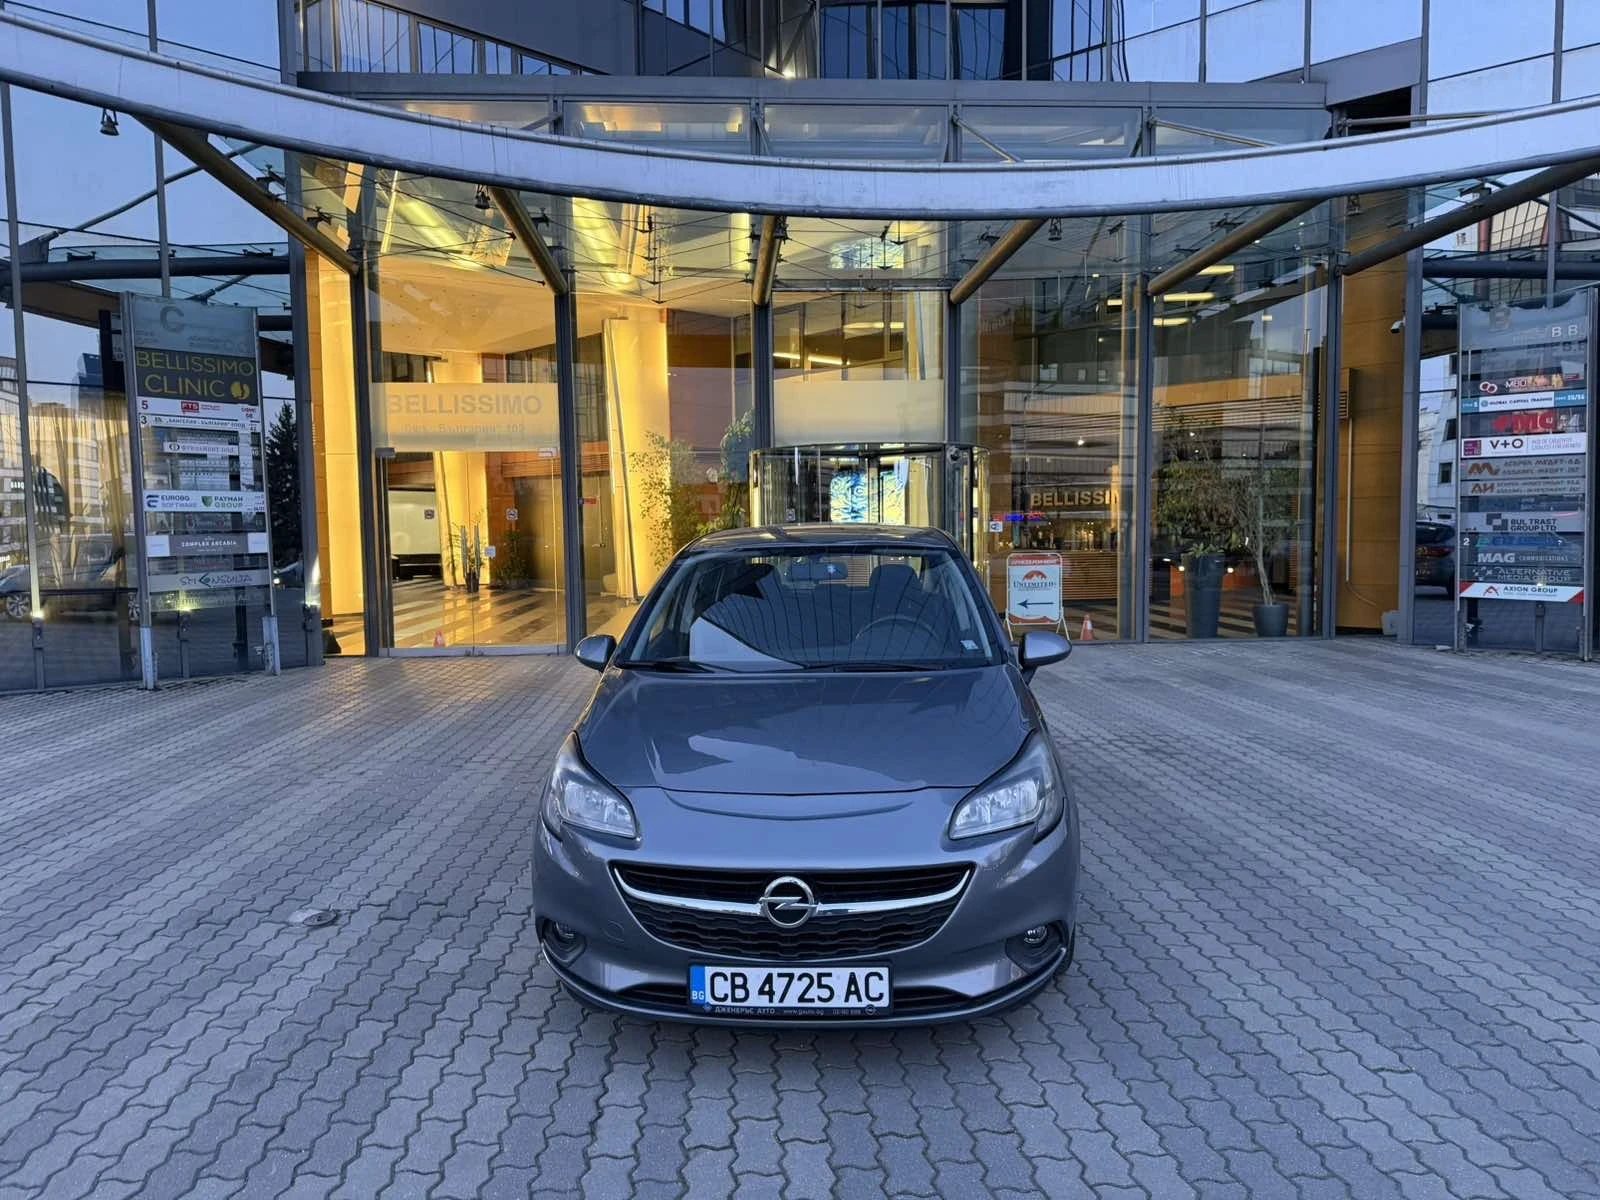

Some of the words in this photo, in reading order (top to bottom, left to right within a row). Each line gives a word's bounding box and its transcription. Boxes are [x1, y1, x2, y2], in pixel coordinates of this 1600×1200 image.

[136, 351, 254, 376] BELLISSIMO
[145, 374, 225, 398] CLINIC
[141, 400, 149, 410] 5
[388, 395, 542, 415] BELLISSIMO
[141, 415, 147, 425] 3
[1490, 438, 1524, 449] V+O
[1463, 538, 1470, 546] 2
[1477, 552, 1516, 563] MAG
[1497, 567, 1570, 576] ALTERNATIVE
[710, 972, 750, 1003] CB
[758, 972, 835, 1004] 4725
[844, 972, 884, 1003] AC
[692, 990, 705, 1000] BG
